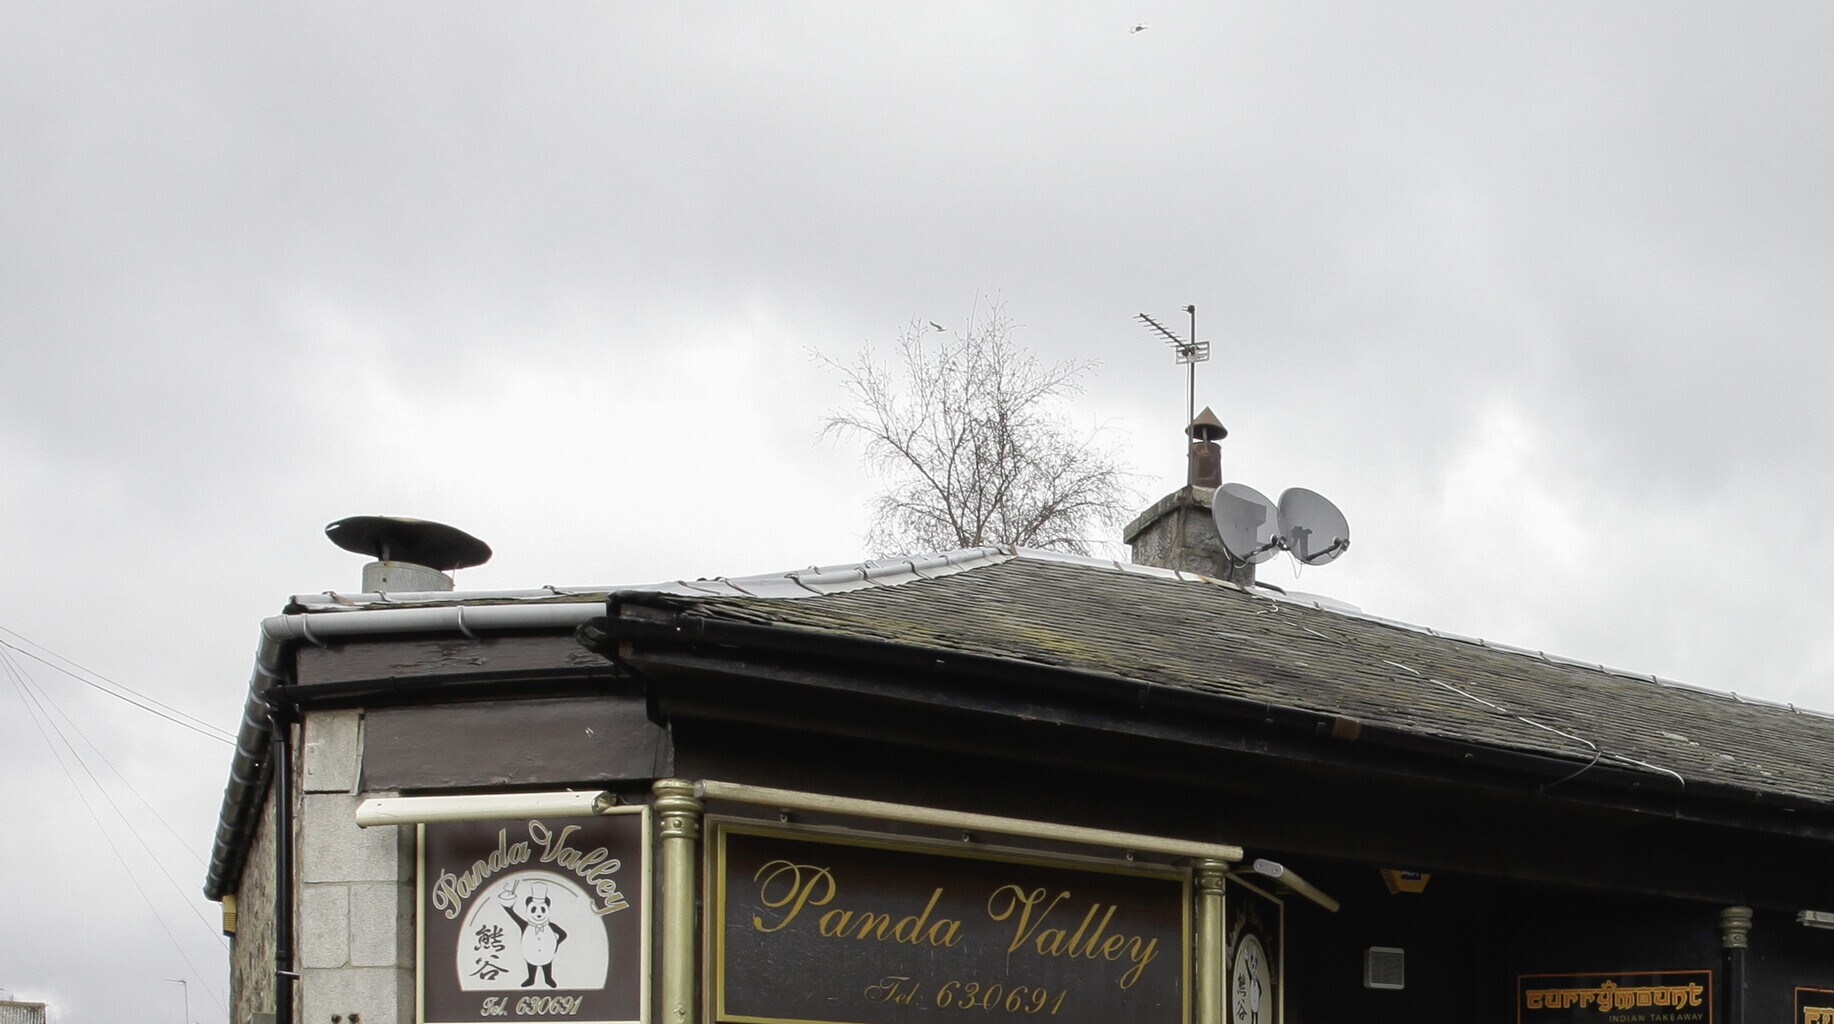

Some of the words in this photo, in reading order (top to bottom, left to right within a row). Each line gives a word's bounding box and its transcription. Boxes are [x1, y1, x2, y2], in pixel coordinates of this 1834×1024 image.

[433, 828, 532, 919] Panda
[528, 819, 630, 917] Valley
[752, 859, 962, 948] Panda
[987, 884, 1159, 990] Valley
[480, 996, 509, 1017] Tel.
[515, 995, 584, 1016] 630691
[936, 980, 1068, 1015] 630691
[1608, 1013, 1646, 1023] INDIAN
